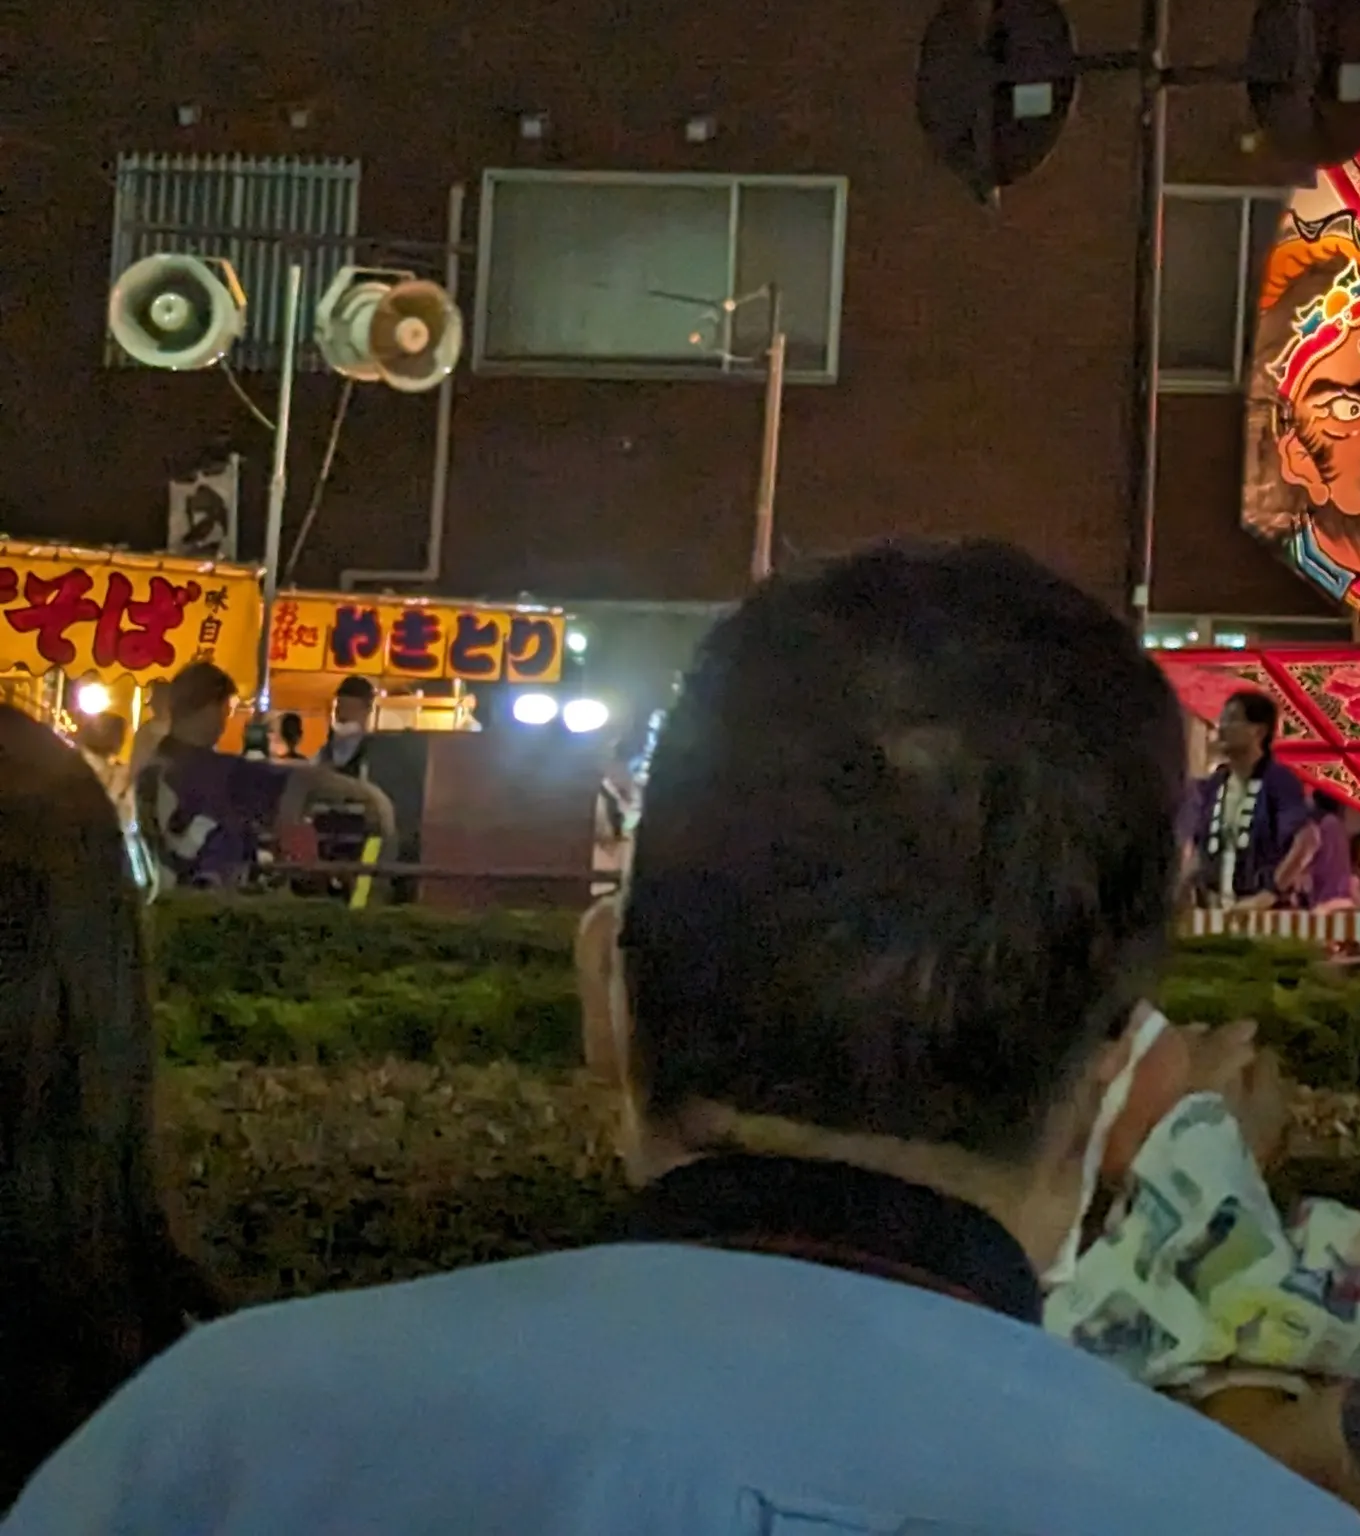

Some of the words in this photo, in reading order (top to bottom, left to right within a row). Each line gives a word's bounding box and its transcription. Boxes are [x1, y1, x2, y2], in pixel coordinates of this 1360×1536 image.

[0, 566, 201, 670] そば
[333, 606, 554, 676] やきとり
